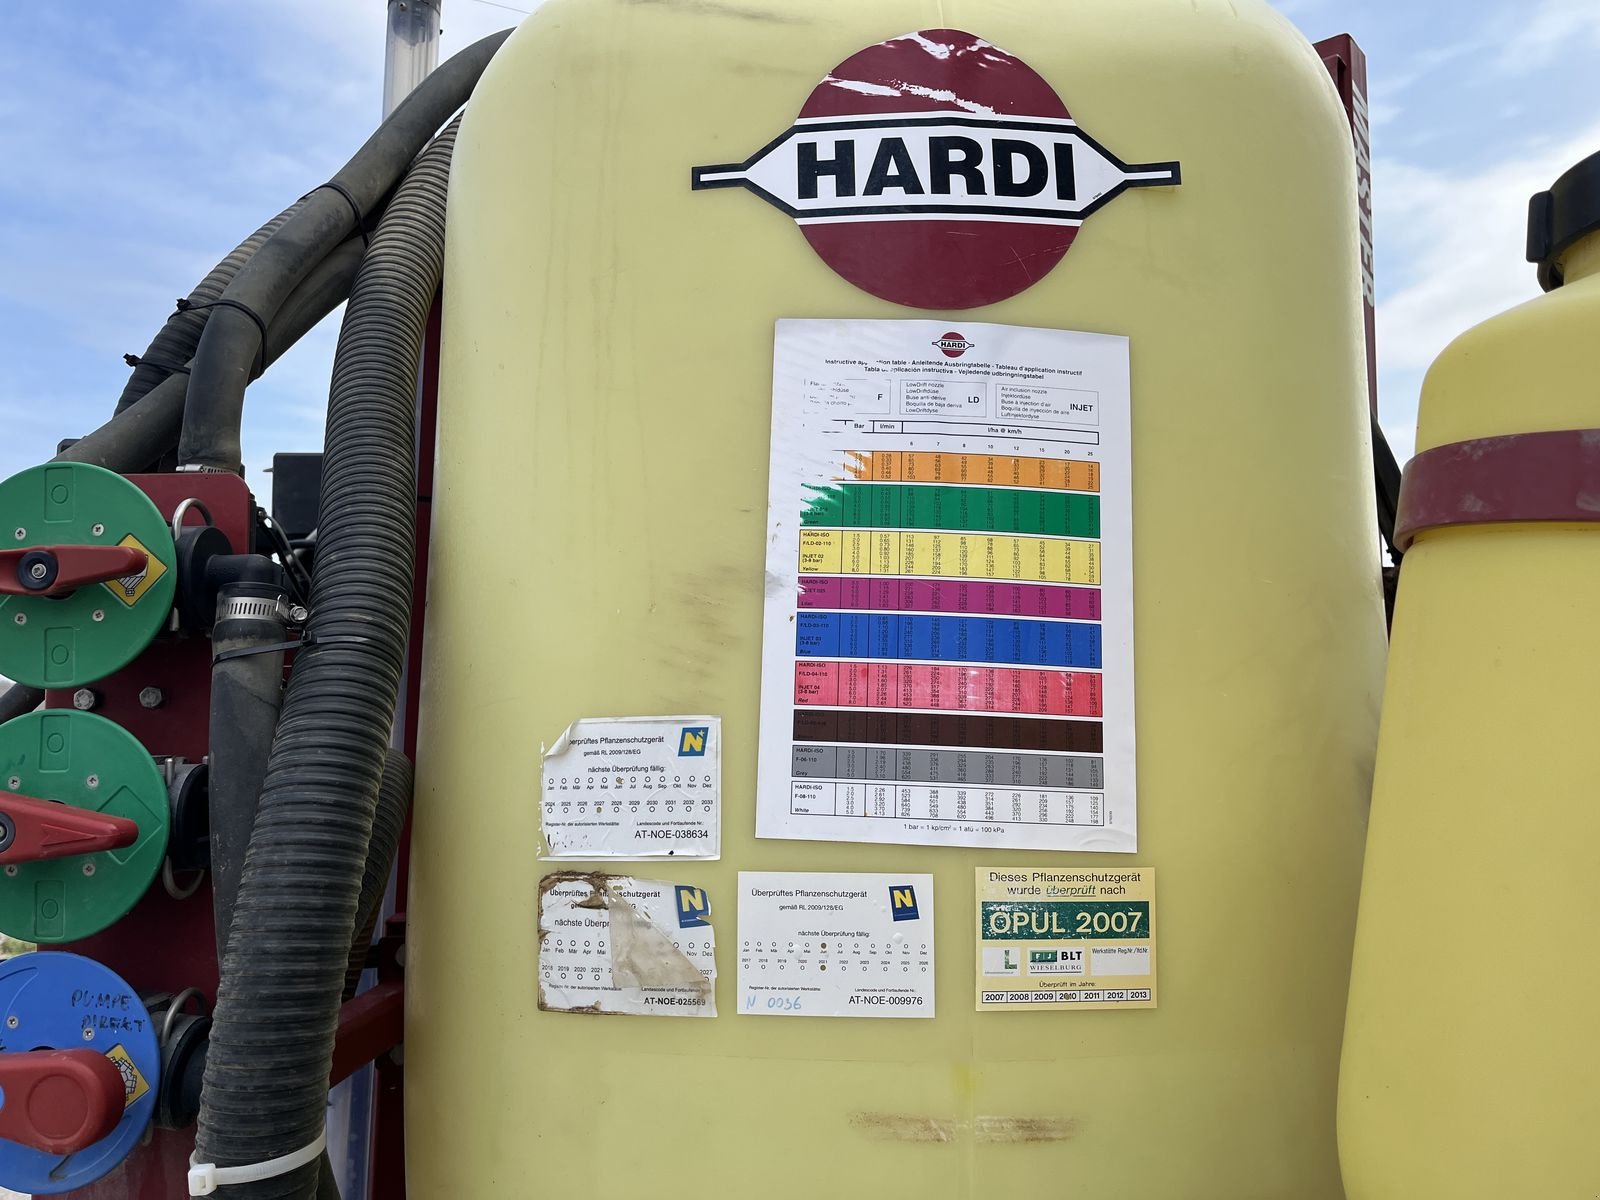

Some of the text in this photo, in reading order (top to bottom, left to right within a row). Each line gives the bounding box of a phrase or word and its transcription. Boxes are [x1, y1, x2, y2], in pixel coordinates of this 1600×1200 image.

[797, 135, 1076, 200] HARDI
[944, 361, 991, 369] Ausbringtabelle
[1057, 368, 1083, 376] instructif
[967, 396, 980, 404] LD
[1070, 403, 1093, 412] INJET
[569, 736, 664, 746] erprüftes Pflanzenschutzgerät
[682, 732, 703, 752] N
[612, 765, 649, 774] Überprüfung
[650, 765, 666, 773] fällig:
[634, 829, 708, 839] AT-NOE-038634
[989, 871, 1141, 884] Dieses Pflanzenschutzgerät
[550, 889, 588, 898] Überprüftes
[751, 888, 868, 899] Überprüftes Pflanzenschutzgerät
[1007, 885, 1126, 897] wurde überprüft nach
[680, 888, 704, 912] N
[893, 889, 914, 909] N
[554, 918, 610, 928] nächste Überpr
[1076, 911, 1143, 933] 2007
[821, 929, 855, 938] Überprüfung
[1061, 951, 1083, 961] BLT
[848, 995, 923, 1005] AT-NOE-009976
[985, 993, 1005, 1001] 2007
[1009, 993, 1030, 1001] 2008
[1084, 992, 1100, 1000] 2011
[1130, 991, 1147, 999] 2013
[643, 997, 706, 1006] AT-NOE-025569
[767, 996, 802, 1010] 0036
